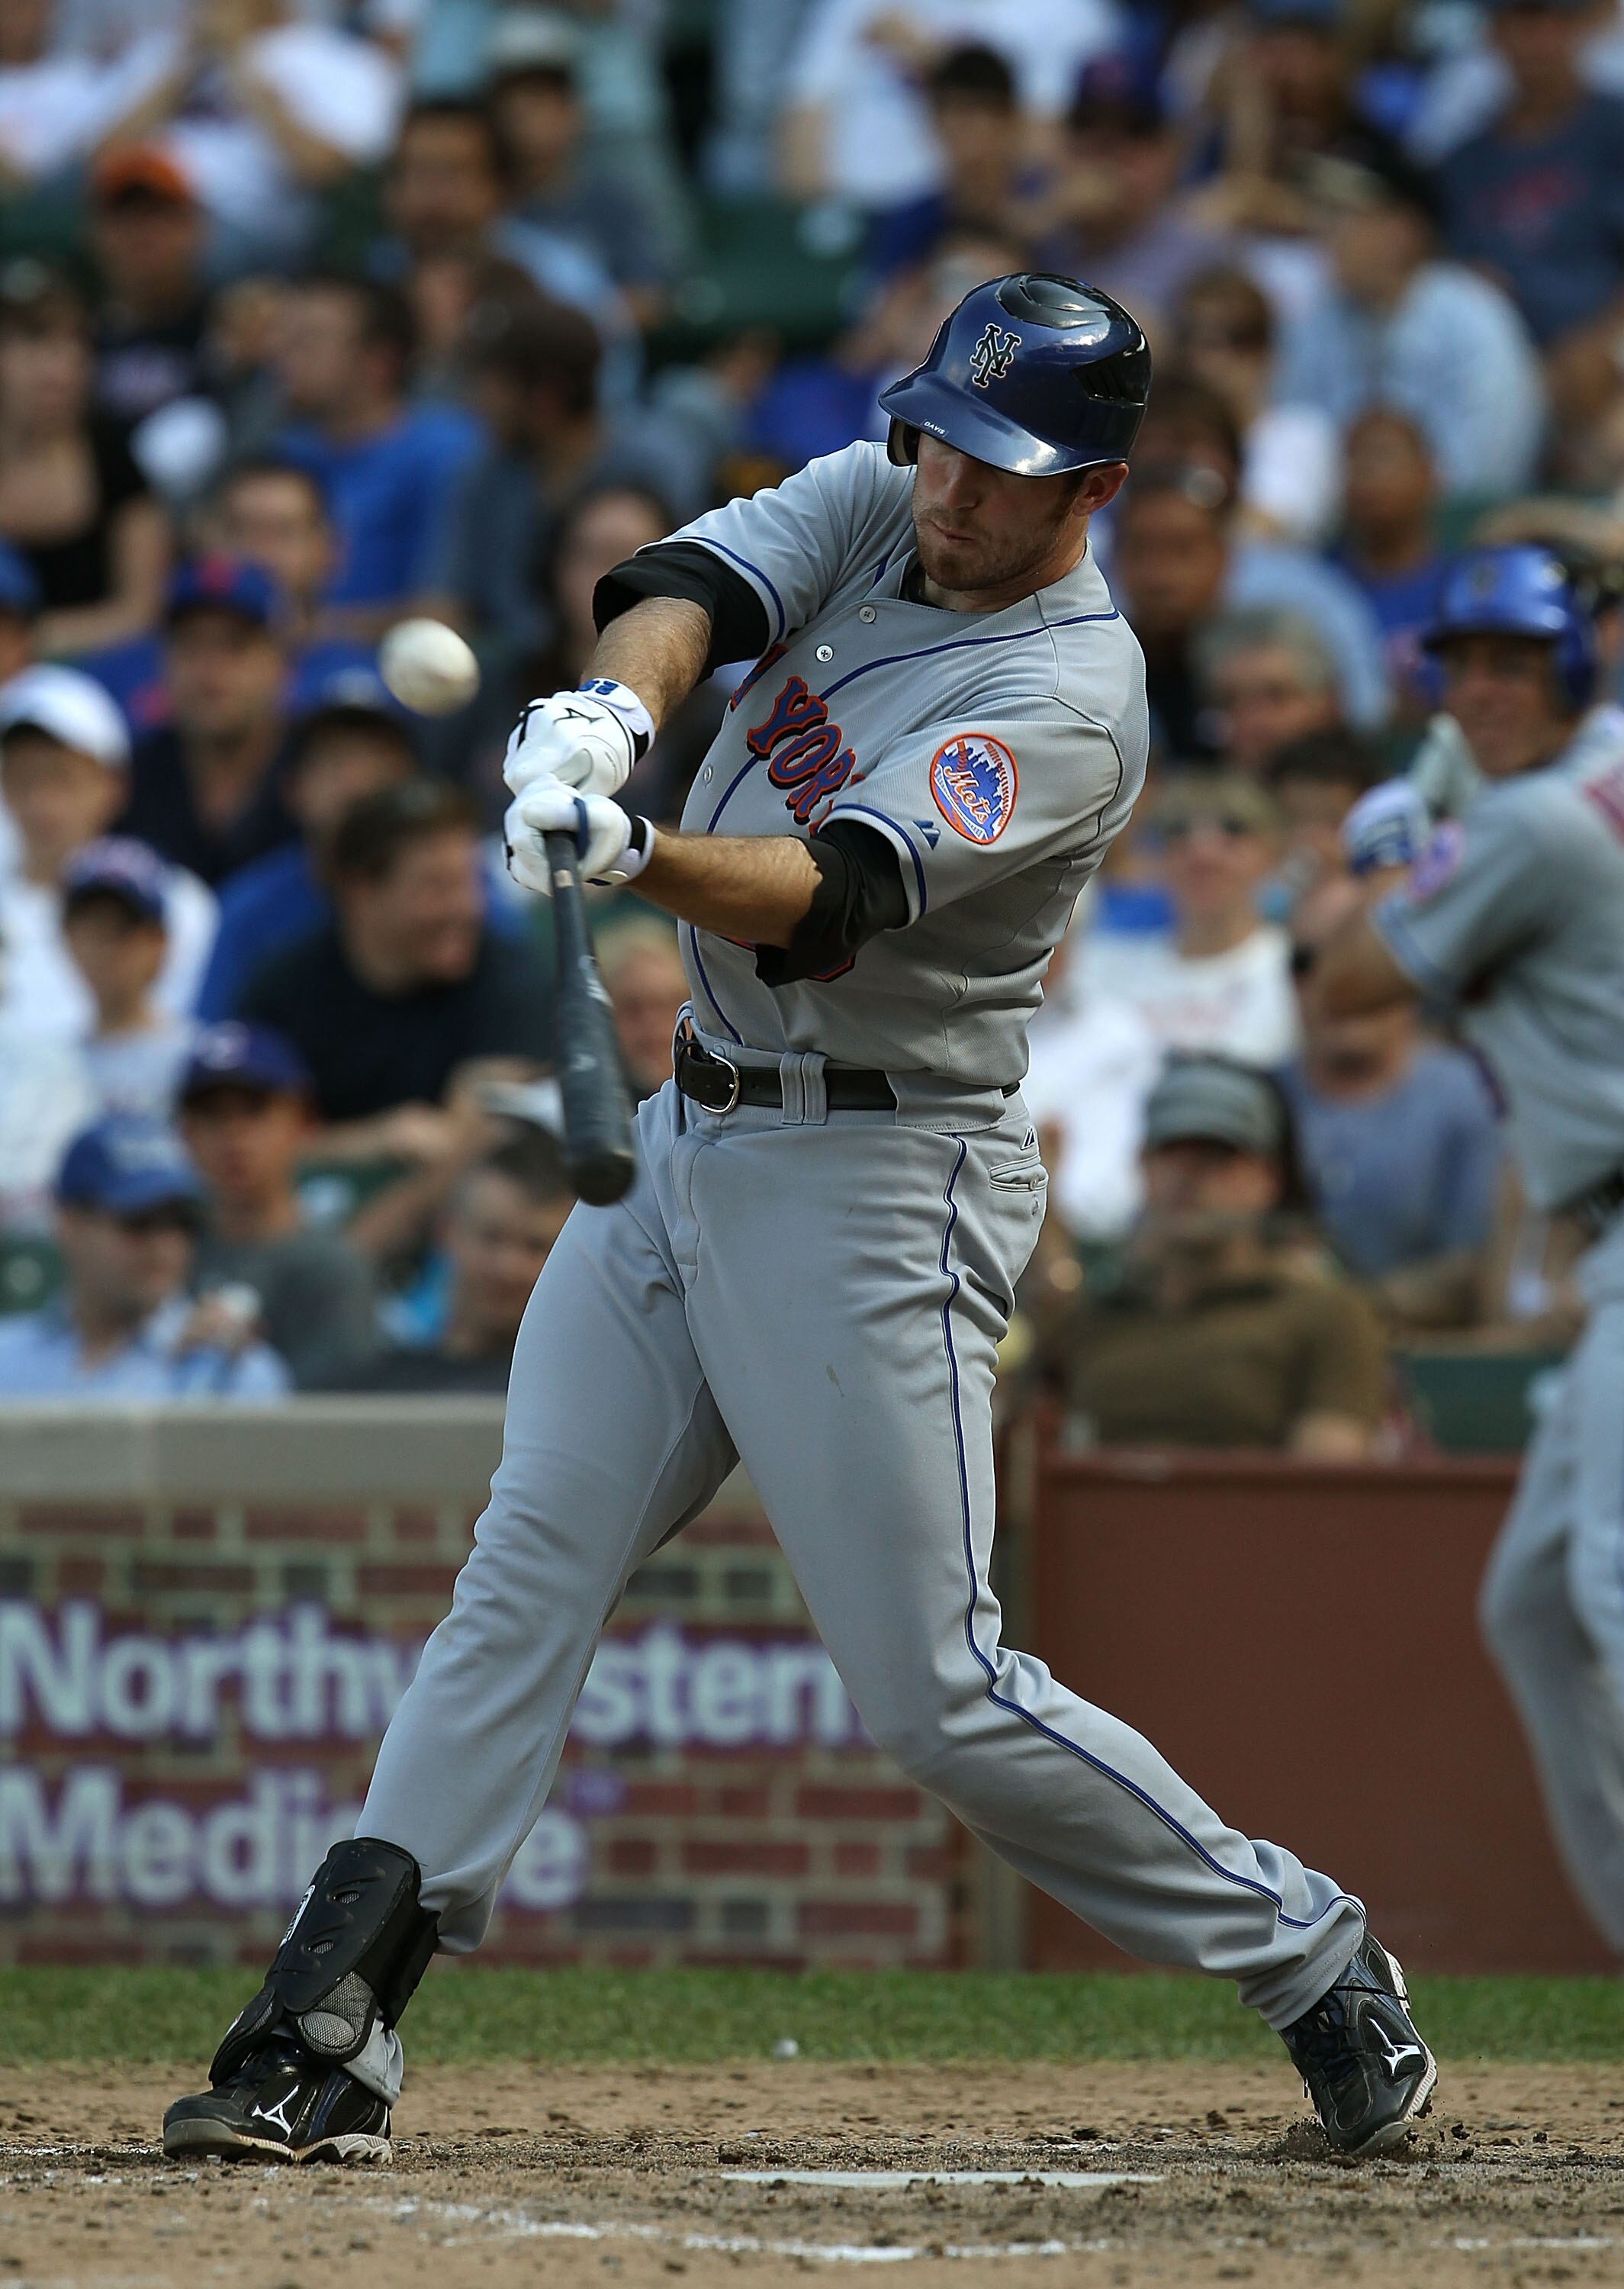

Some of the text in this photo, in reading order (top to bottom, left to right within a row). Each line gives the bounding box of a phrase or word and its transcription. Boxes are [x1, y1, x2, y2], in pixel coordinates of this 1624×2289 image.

[970, 323, 1021, 388] NY
[923, 420, 946, 435] DAVIS
[747, 675, 866, 838] YOR
[943, 765, 992, 826] Mets
[0, 1766, 587, 1908] Medie
